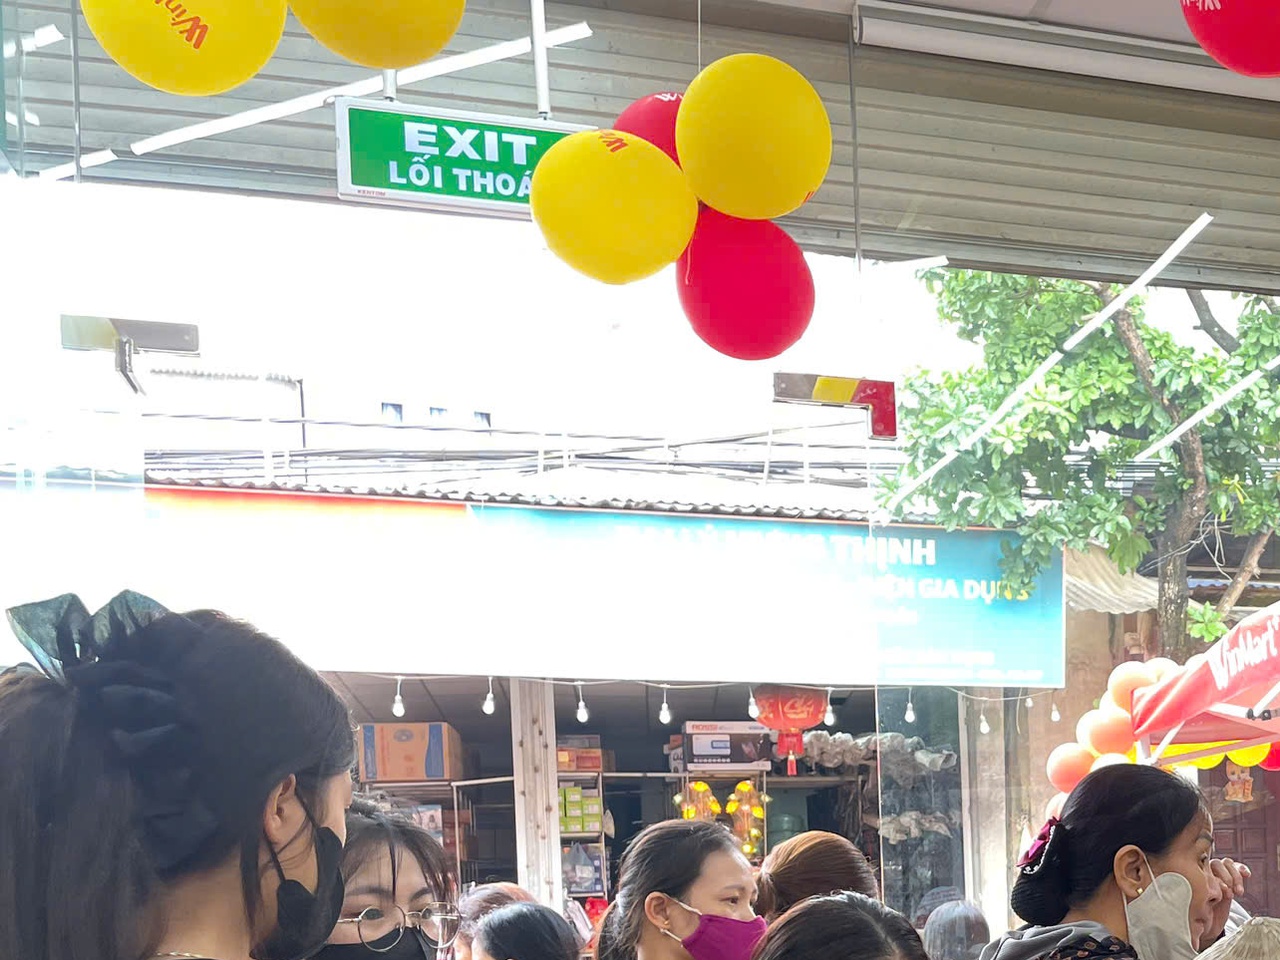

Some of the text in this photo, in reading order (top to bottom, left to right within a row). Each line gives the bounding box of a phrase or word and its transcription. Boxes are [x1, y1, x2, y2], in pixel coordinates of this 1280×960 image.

[403, 120, 537, 165] EXIT
[388, 154, 531, 197] LỐI THOÁ
[829, 536, 936, 569] THỊNH
[918, 580, 959, 599] GIA
